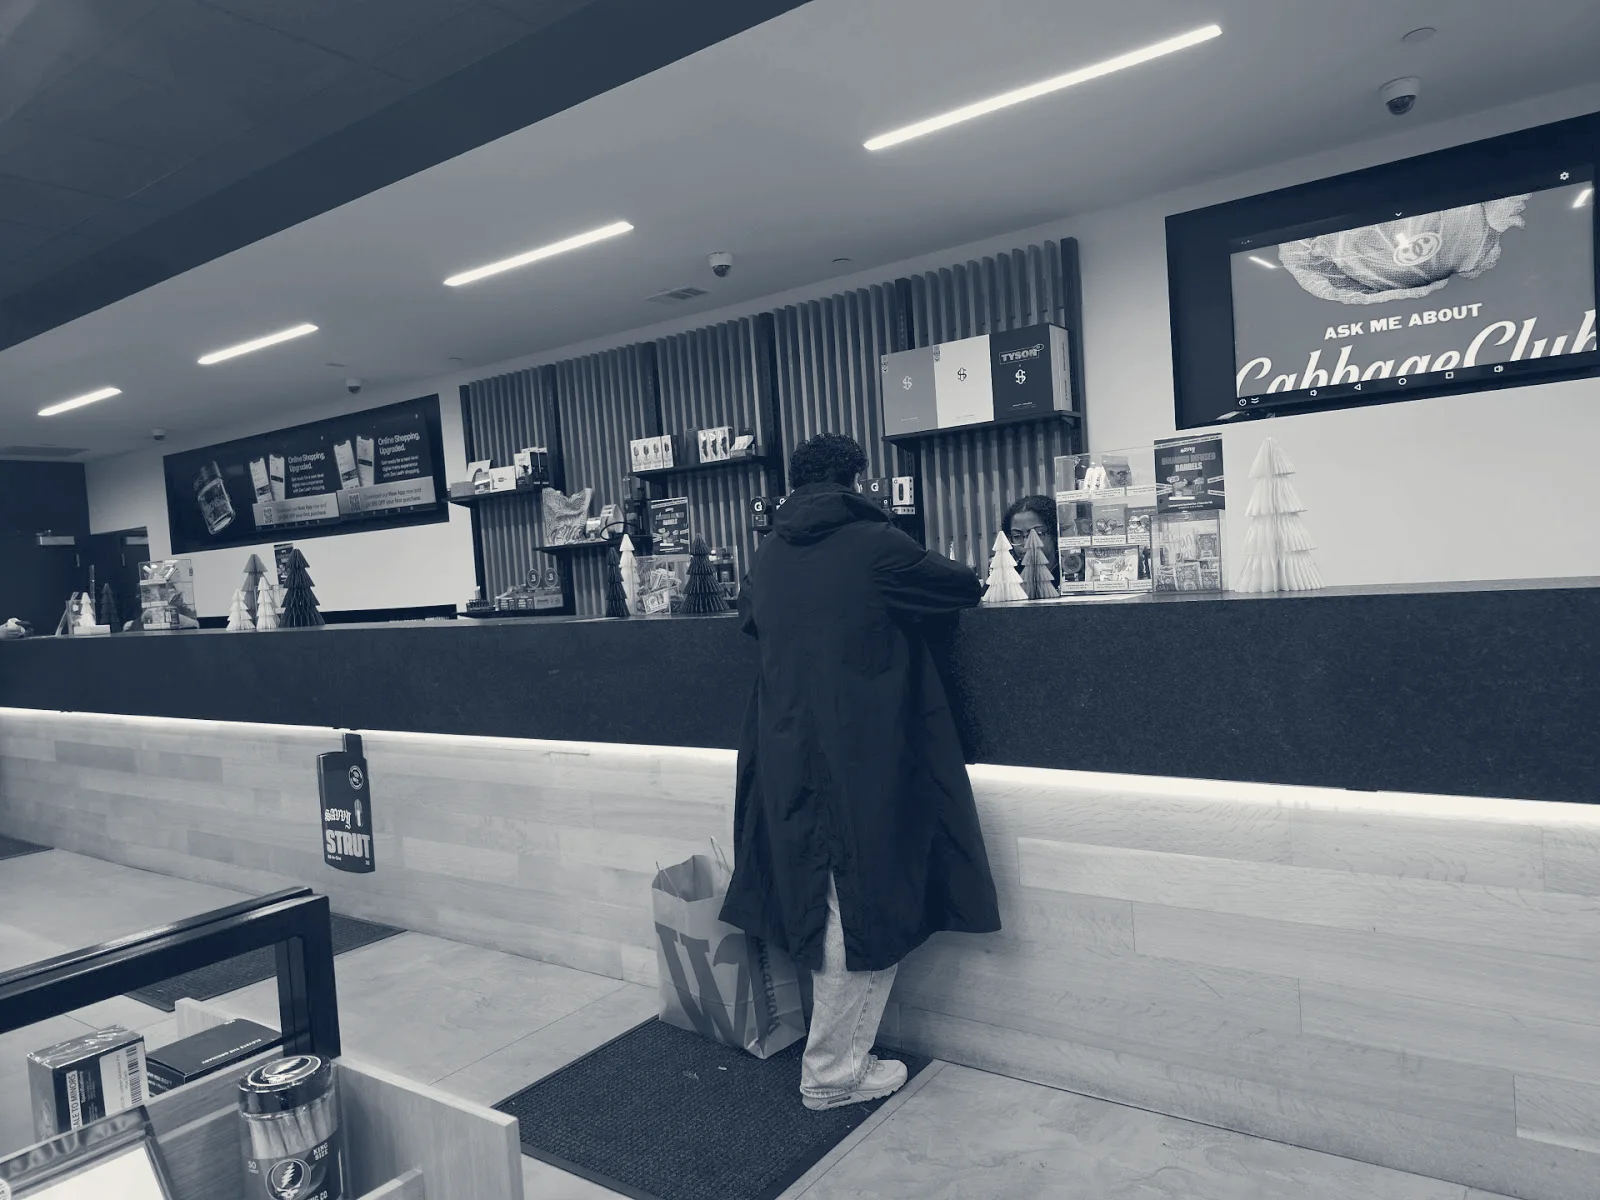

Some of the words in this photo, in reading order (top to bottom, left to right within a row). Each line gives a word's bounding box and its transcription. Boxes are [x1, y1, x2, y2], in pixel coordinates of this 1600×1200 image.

[1324, 321, 1365, 341] ASK
[1370, 316, 1402, 333] ME
[1408, 302, 1483, 328] ABOUT
[1001, 349, 1038, 362] TYSON
[378, 437, 394, 446] Online
[287, 455, 302, 464] Online
[325, 829, 371, 859] STRUT
[68, 1073, 78, 1102] MINORS
[71, 1102, 79, 1113] TO
[313, 1142, 328, 1155] KING
[314, 1149, 329, 1161] SIZE
